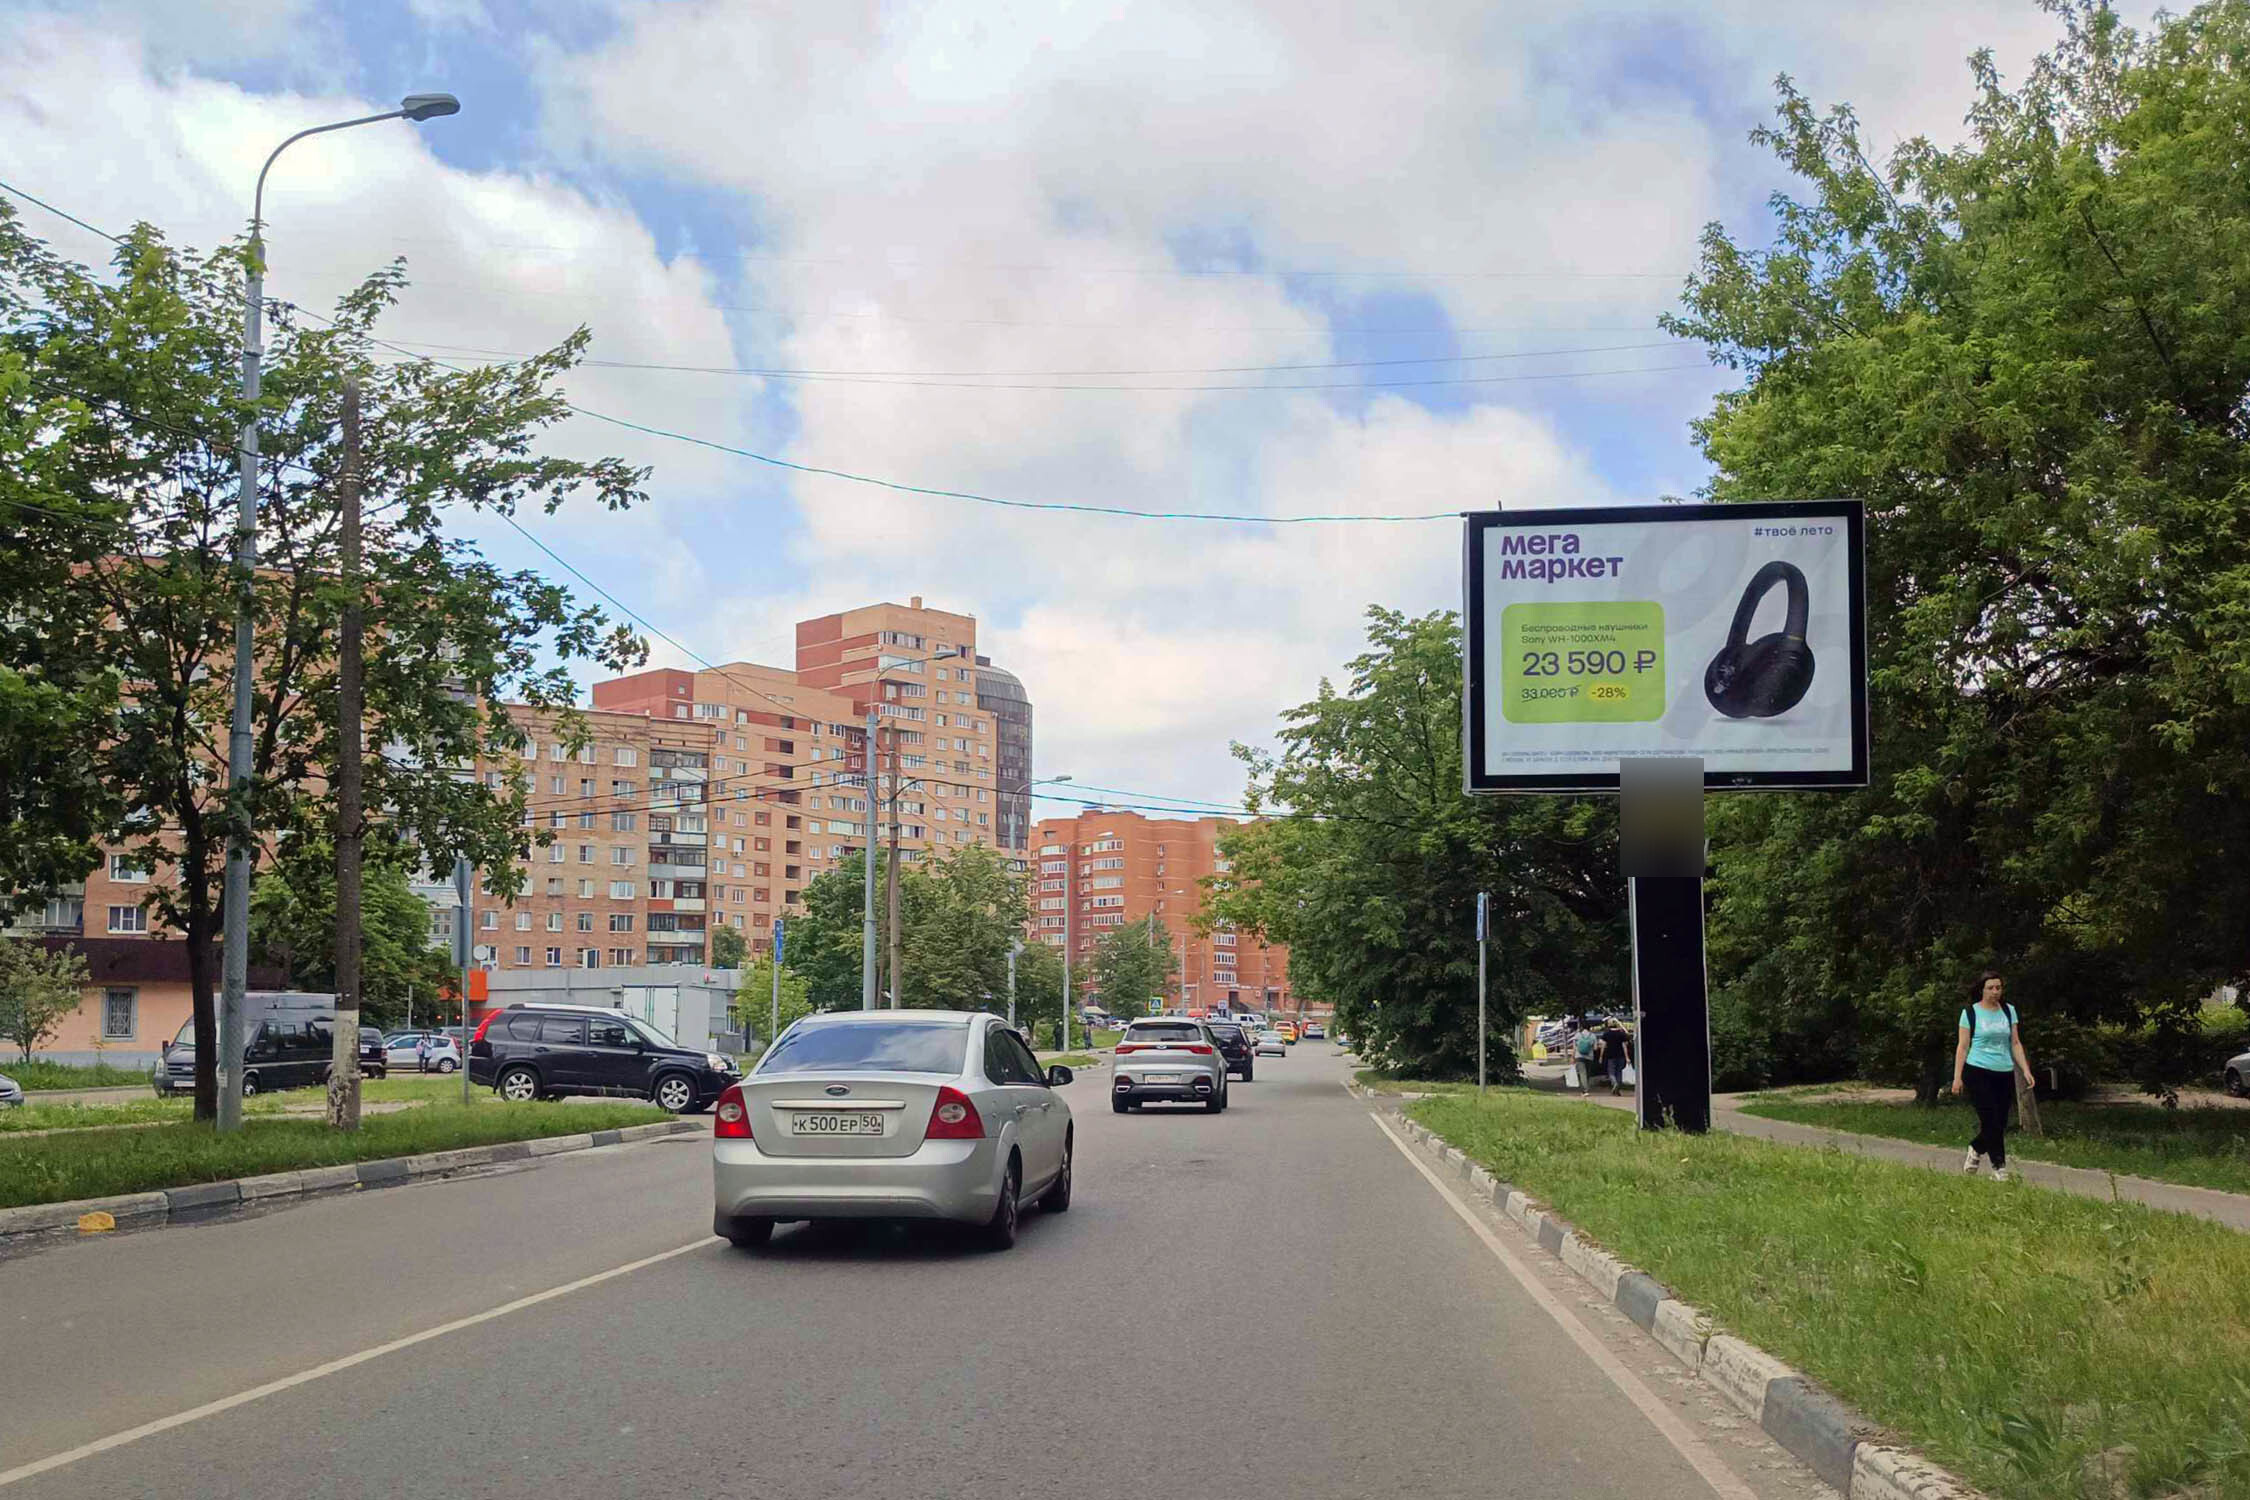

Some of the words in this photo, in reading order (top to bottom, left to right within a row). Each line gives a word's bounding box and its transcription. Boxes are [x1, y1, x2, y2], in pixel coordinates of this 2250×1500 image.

[1754, 525, 1797, 537] #твоё
[1800, 526, 1833, 536] лето
[1501, 533, 1580, 556] мега
[1501, 556, 1624, 584] маркет
[1521, 623, 1597, 634] Беспроводные
[1598, 623, 1648, 633] наушники
[1521, 635, 1546, 646] Sony
[1591, 687, 1627, 699] -28%
